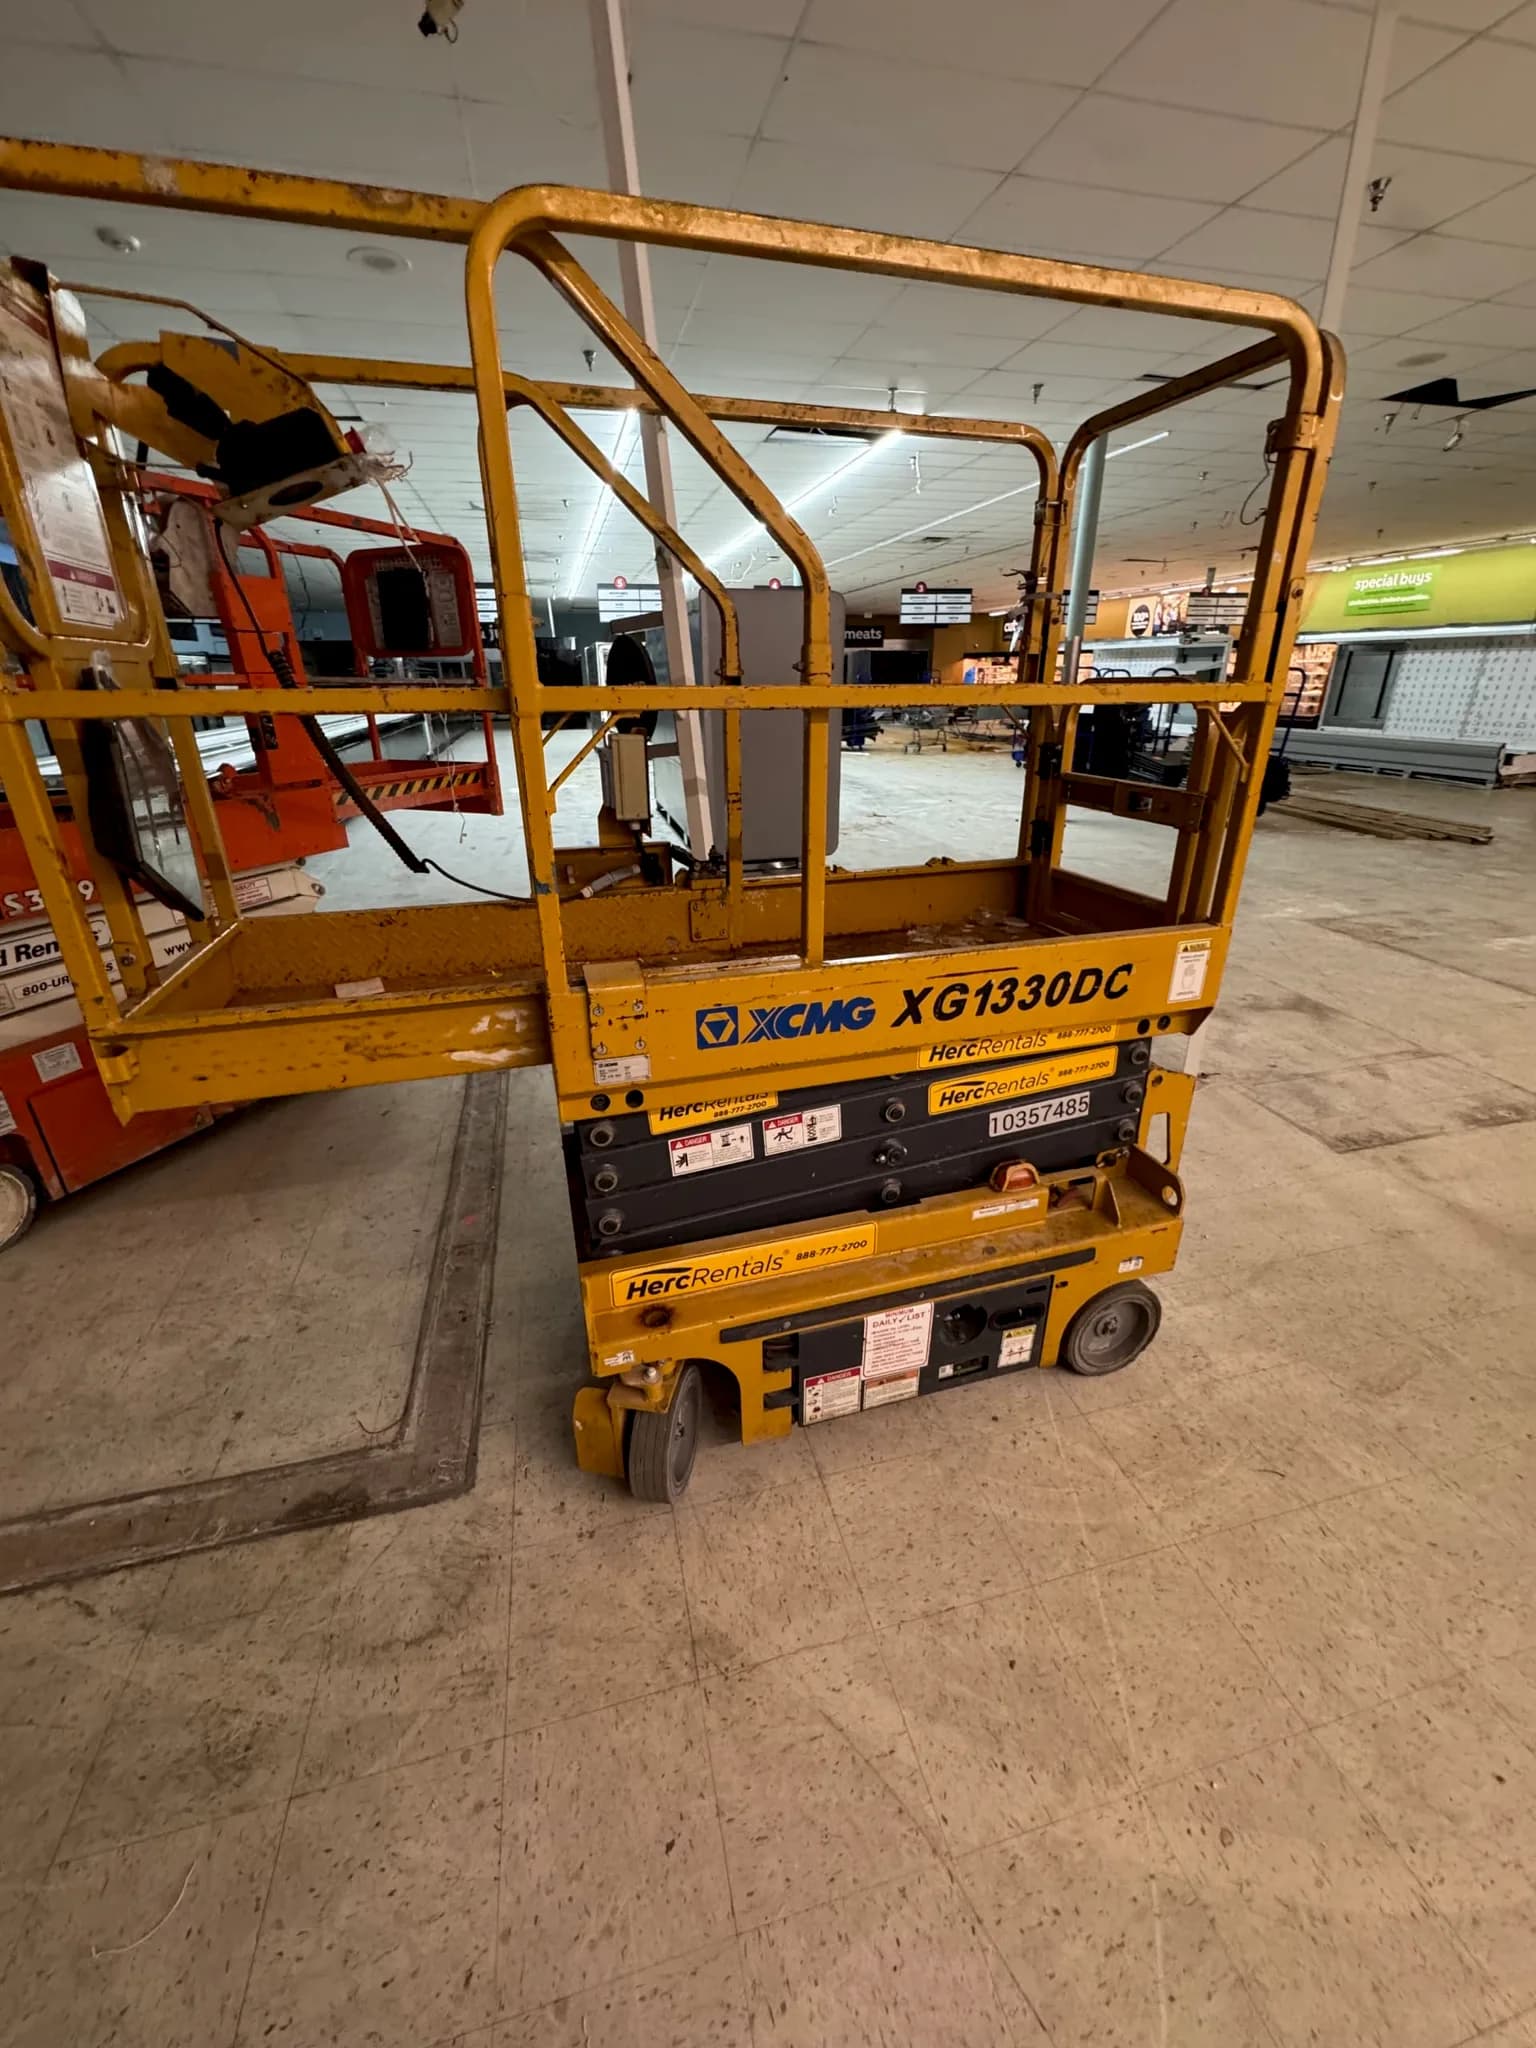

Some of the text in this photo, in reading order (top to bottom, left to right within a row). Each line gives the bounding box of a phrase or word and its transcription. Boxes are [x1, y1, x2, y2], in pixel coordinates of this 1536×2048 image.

[1354, 573, 1397, 591] special
[1400, 572, 1433, 587] buys
[844, 628, 882, 639] meats
[740, 963, 1133, 1044] XCMG XG1330DC
[1058, 1061, 1110, 1077] 888-777-2700
[713, 1101, 767, 1118] 888-777-2700
[991, 1095, 1089, 1134] 10357485
[777, 1115, 800, 1126] DANGER
[684, 1136, 708, 1147] DANGER
[796, 1240, 867, 1261] 888-777-2700
[872, 1311, 925, 1329] DAILY LIST
